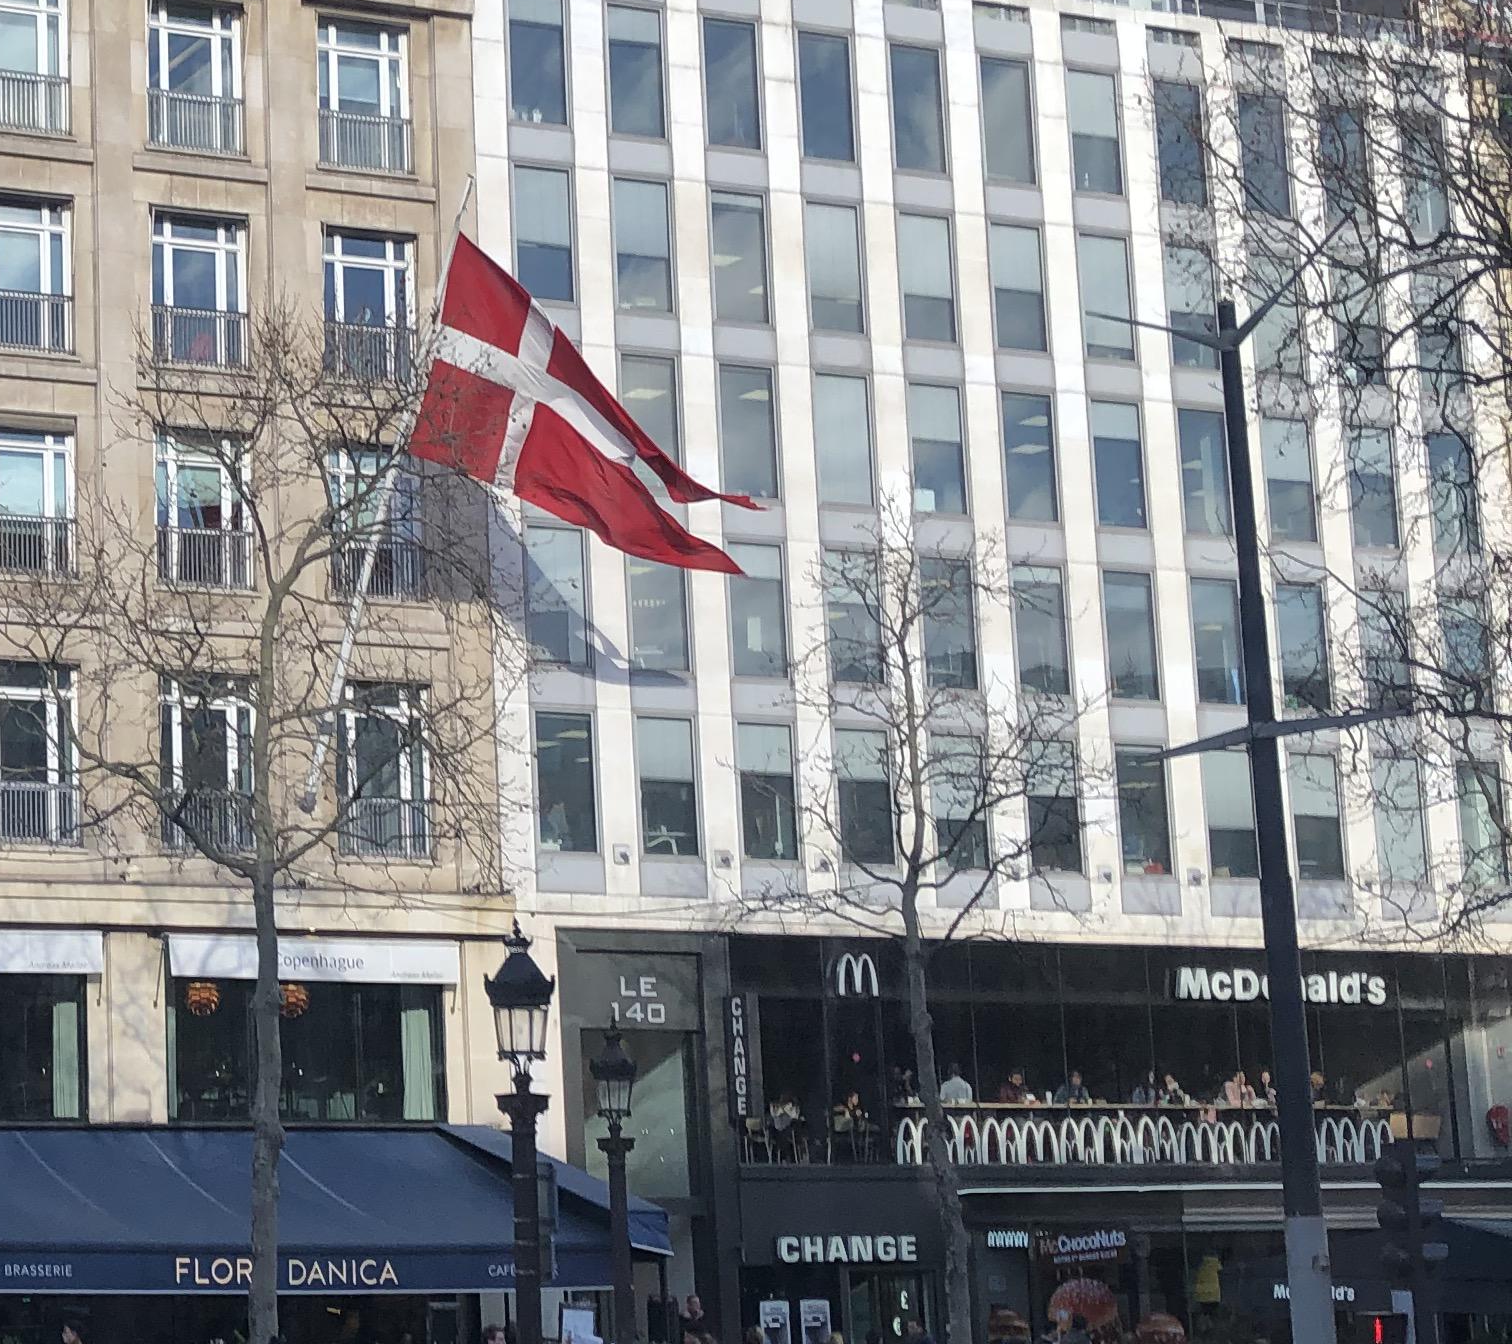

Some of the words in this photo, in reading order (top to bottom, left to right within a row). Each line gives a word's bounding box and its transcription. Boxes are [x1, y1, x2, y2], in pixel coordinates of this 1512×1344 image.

[620, 976, 658, 998] LE
[611, 1002, 666, 1024] 140
[731, 997, 747, 1116] CHANGE
[777, 1235, 918, 1263] CHANGE
[4, 1264, 73, 1277] BRASSERIE
[175, 1257, 254, 1285] FLOR
[288, 1259, 399, 1285] DANICA
[1273, 1284, 1355, 1302] Mld's
